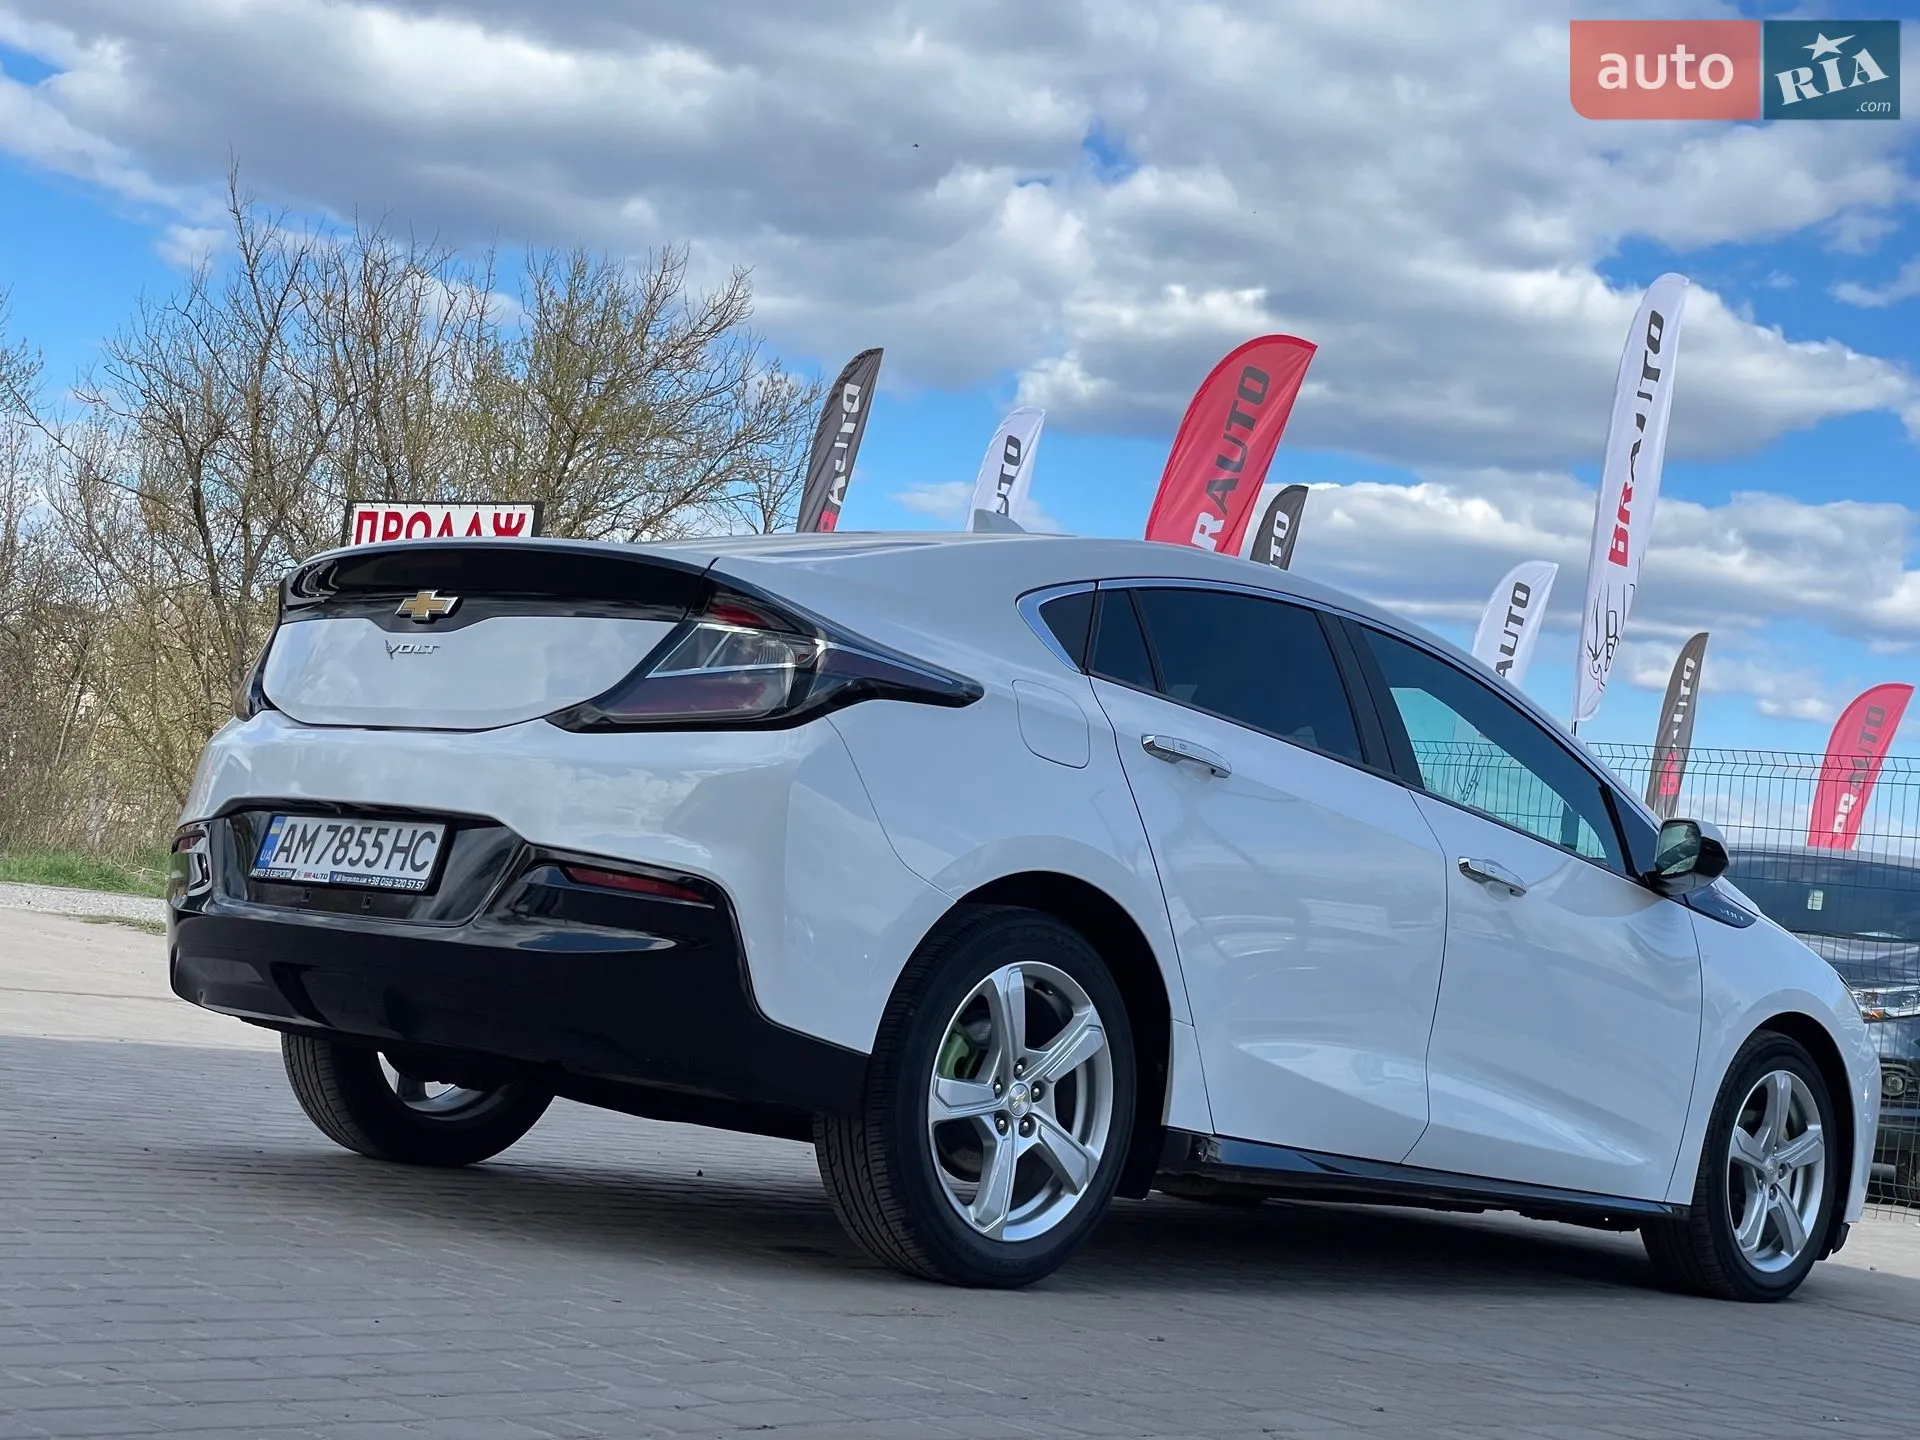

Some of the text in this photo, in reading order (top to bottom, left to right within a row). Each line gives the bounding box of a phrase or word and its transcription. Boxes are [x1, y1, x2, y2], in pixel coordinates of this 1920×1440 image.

[1495, 581, 1531, 678] AUTO
[384, 640, 441, 660] VOLT
[260, 851, 271, 861] UA
